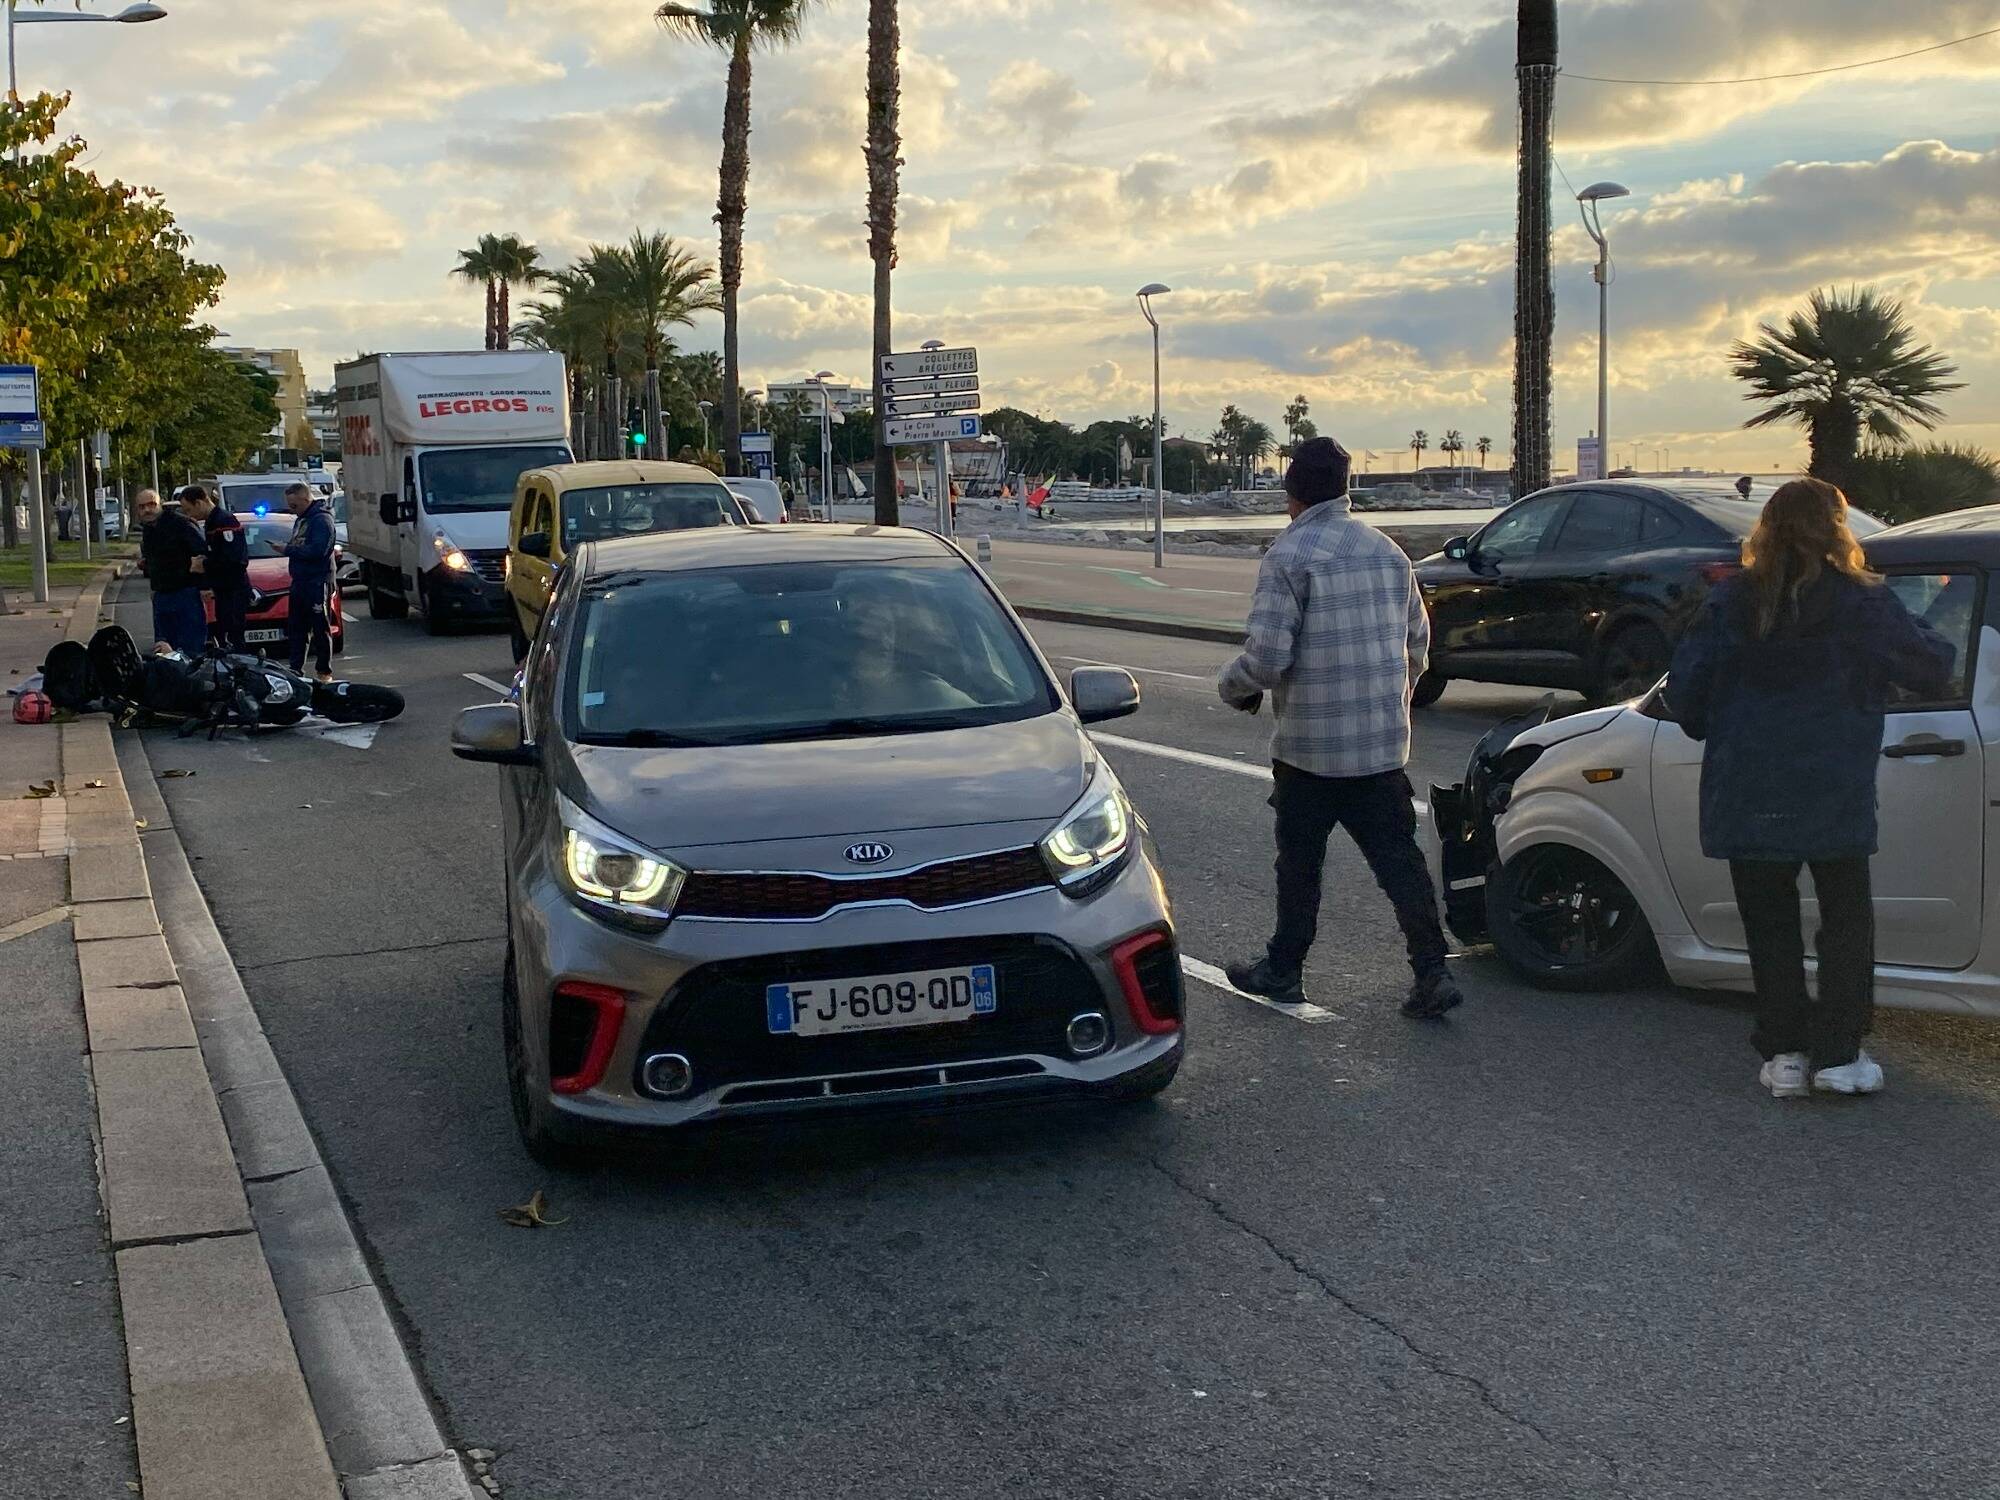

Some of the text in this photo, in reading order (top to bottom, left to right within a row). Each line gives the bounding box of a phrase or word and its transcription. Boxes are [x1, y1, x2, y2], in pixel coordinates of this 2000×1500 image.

[925, 352, 973, 363] COLLETTES
[923, 380, 976, 391] VAL FLEURI
[419, 399, 528, 418] LEGROS
[904, 422, 913, 431] Le
[963, 421, 973, 433] P
[905, 431, 929, 440] Pierre
[851, 845, 887, 860] KIA
[790, 975, 972, 1024] FJ-609-QD
